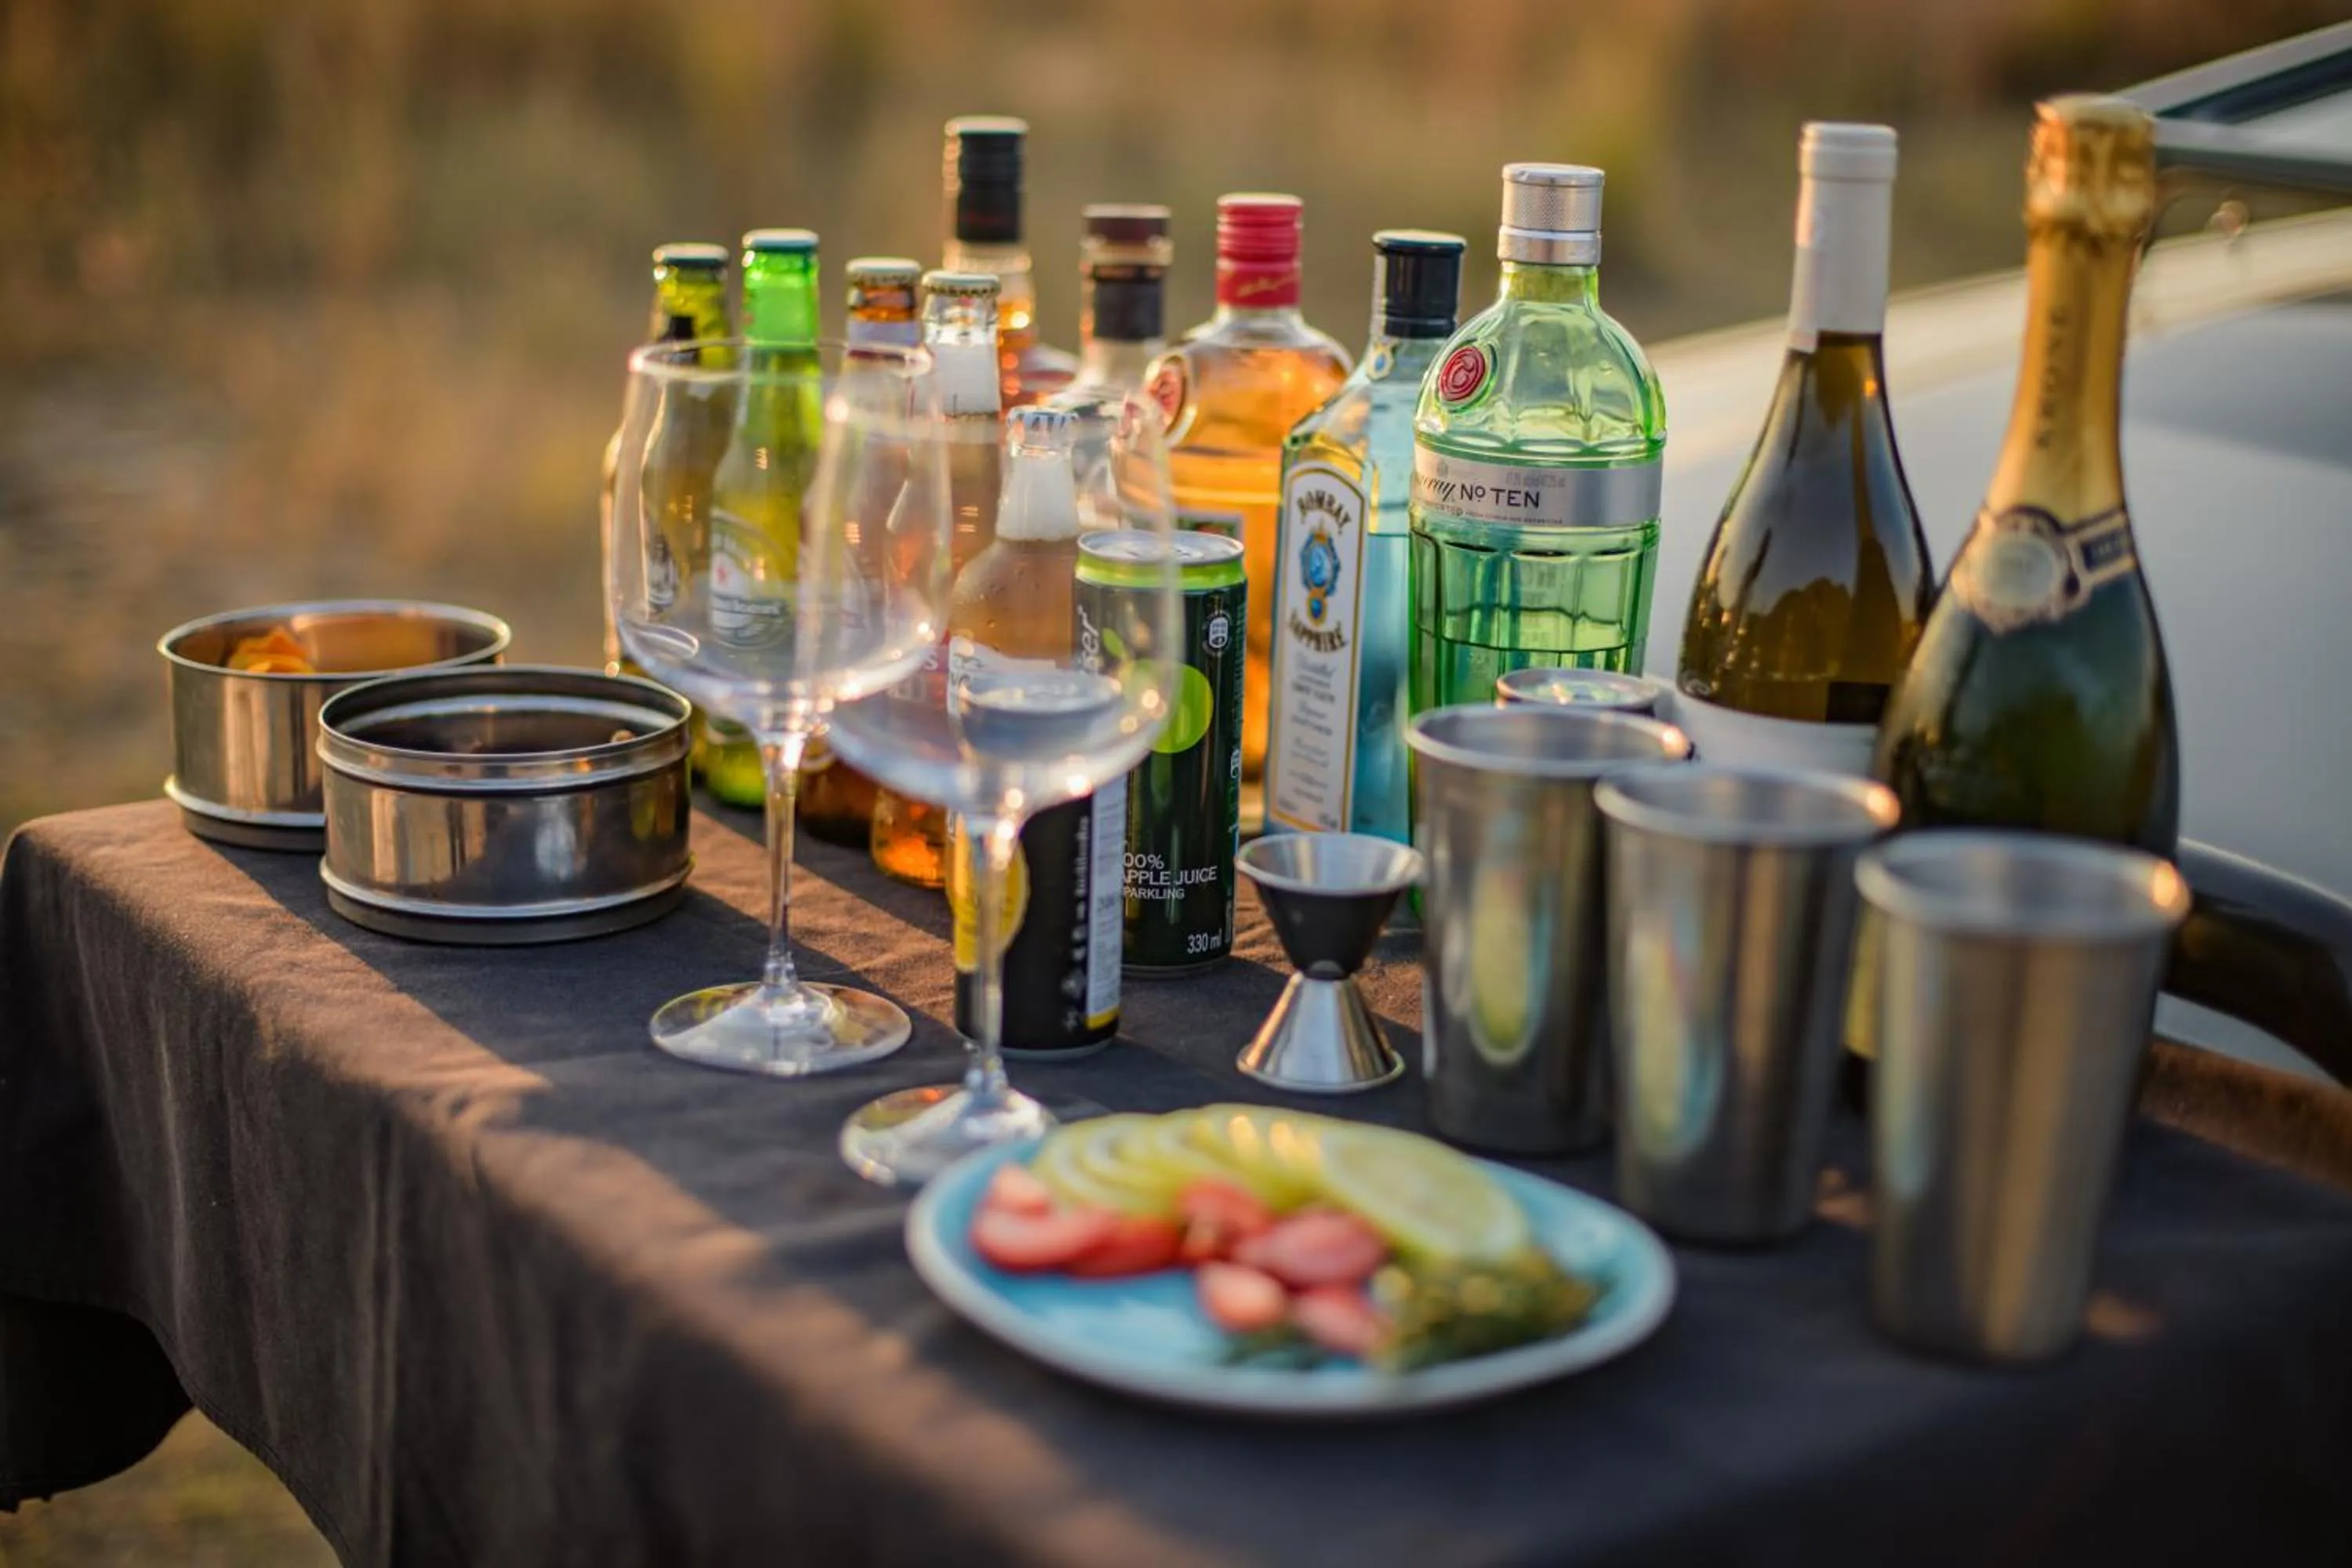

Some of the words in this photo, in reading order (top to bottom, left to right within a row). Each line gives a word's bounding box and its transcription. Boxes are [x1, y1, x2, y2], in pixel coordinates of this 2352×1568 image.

[1490, 488, 1540, 508] TEN
[1298, 489, 1352, 535] BOMBAY
[1290, 608, 1348, 652] SAPPHIRE
[1123, 852, 1165, 869] 00%
[1173, 866, 1218, 885] JUICE
[1123, 886, 1185, 899] PARKLING
[1187, 932, 1209, 954] 330
[1210, 927, 1223, 949] ml
